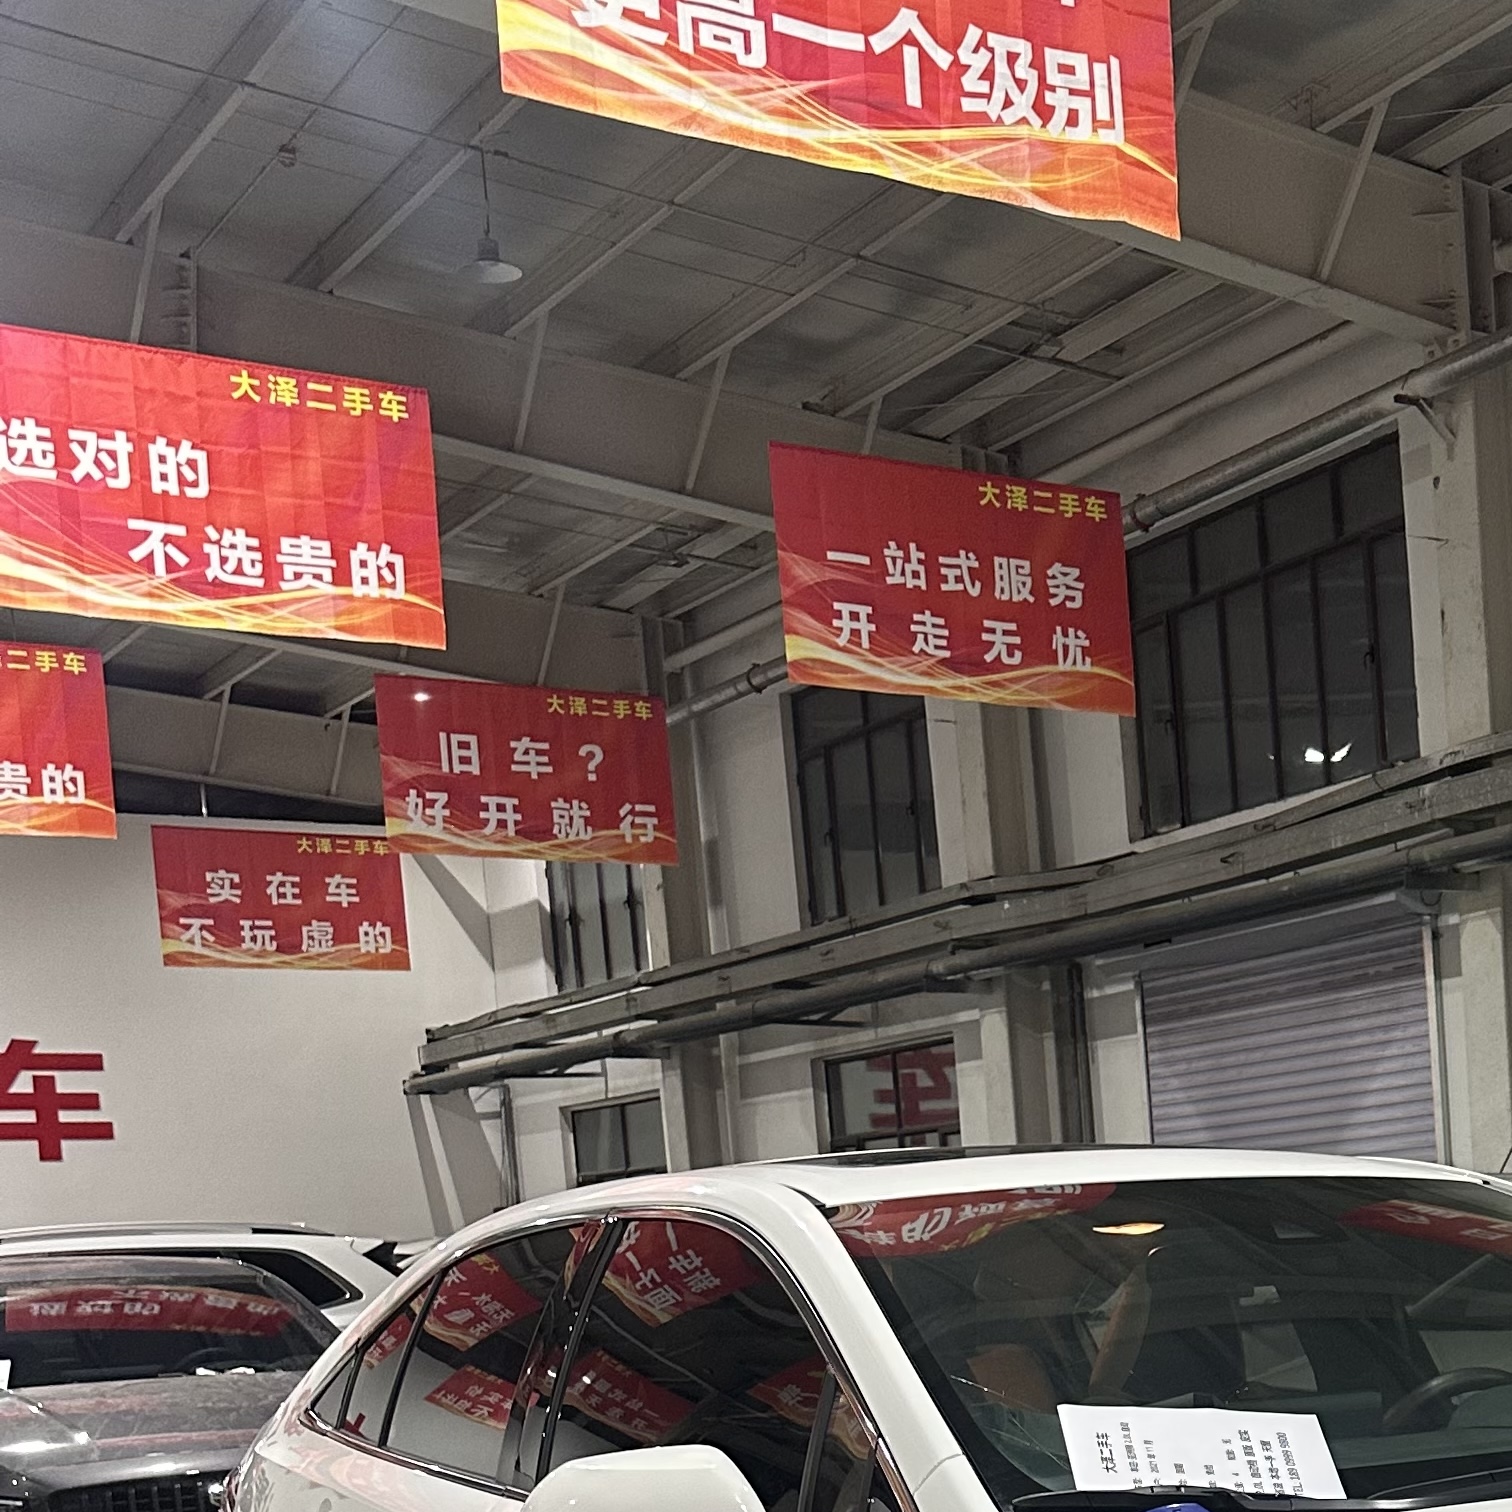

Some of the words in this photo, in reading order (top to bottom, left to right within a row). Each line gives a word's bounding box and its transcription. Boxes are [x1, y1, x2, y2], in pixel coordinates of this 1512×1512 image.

[229, 369, 410, 423] 大泽二手车
[0, 416, 210, 499] 选对的
[978, 481, 1108, 522] 大泽二手车
[127, 518, 406, 600] 不选贵的
[826, 541, 1086, 609] 一站式服务
[832, 602, 1092, 671] 开走无忧
[547, 695, 653, 721] 大泽二手车
[405, 788, 659, 844] 好开就行
[297, 838, 390, 857] 大泽二手车
[205, 868, 360, 908] 实在车
[179, 917, 392, 954] 不玩虚的
[0, 1038, 115, 1162] 车
